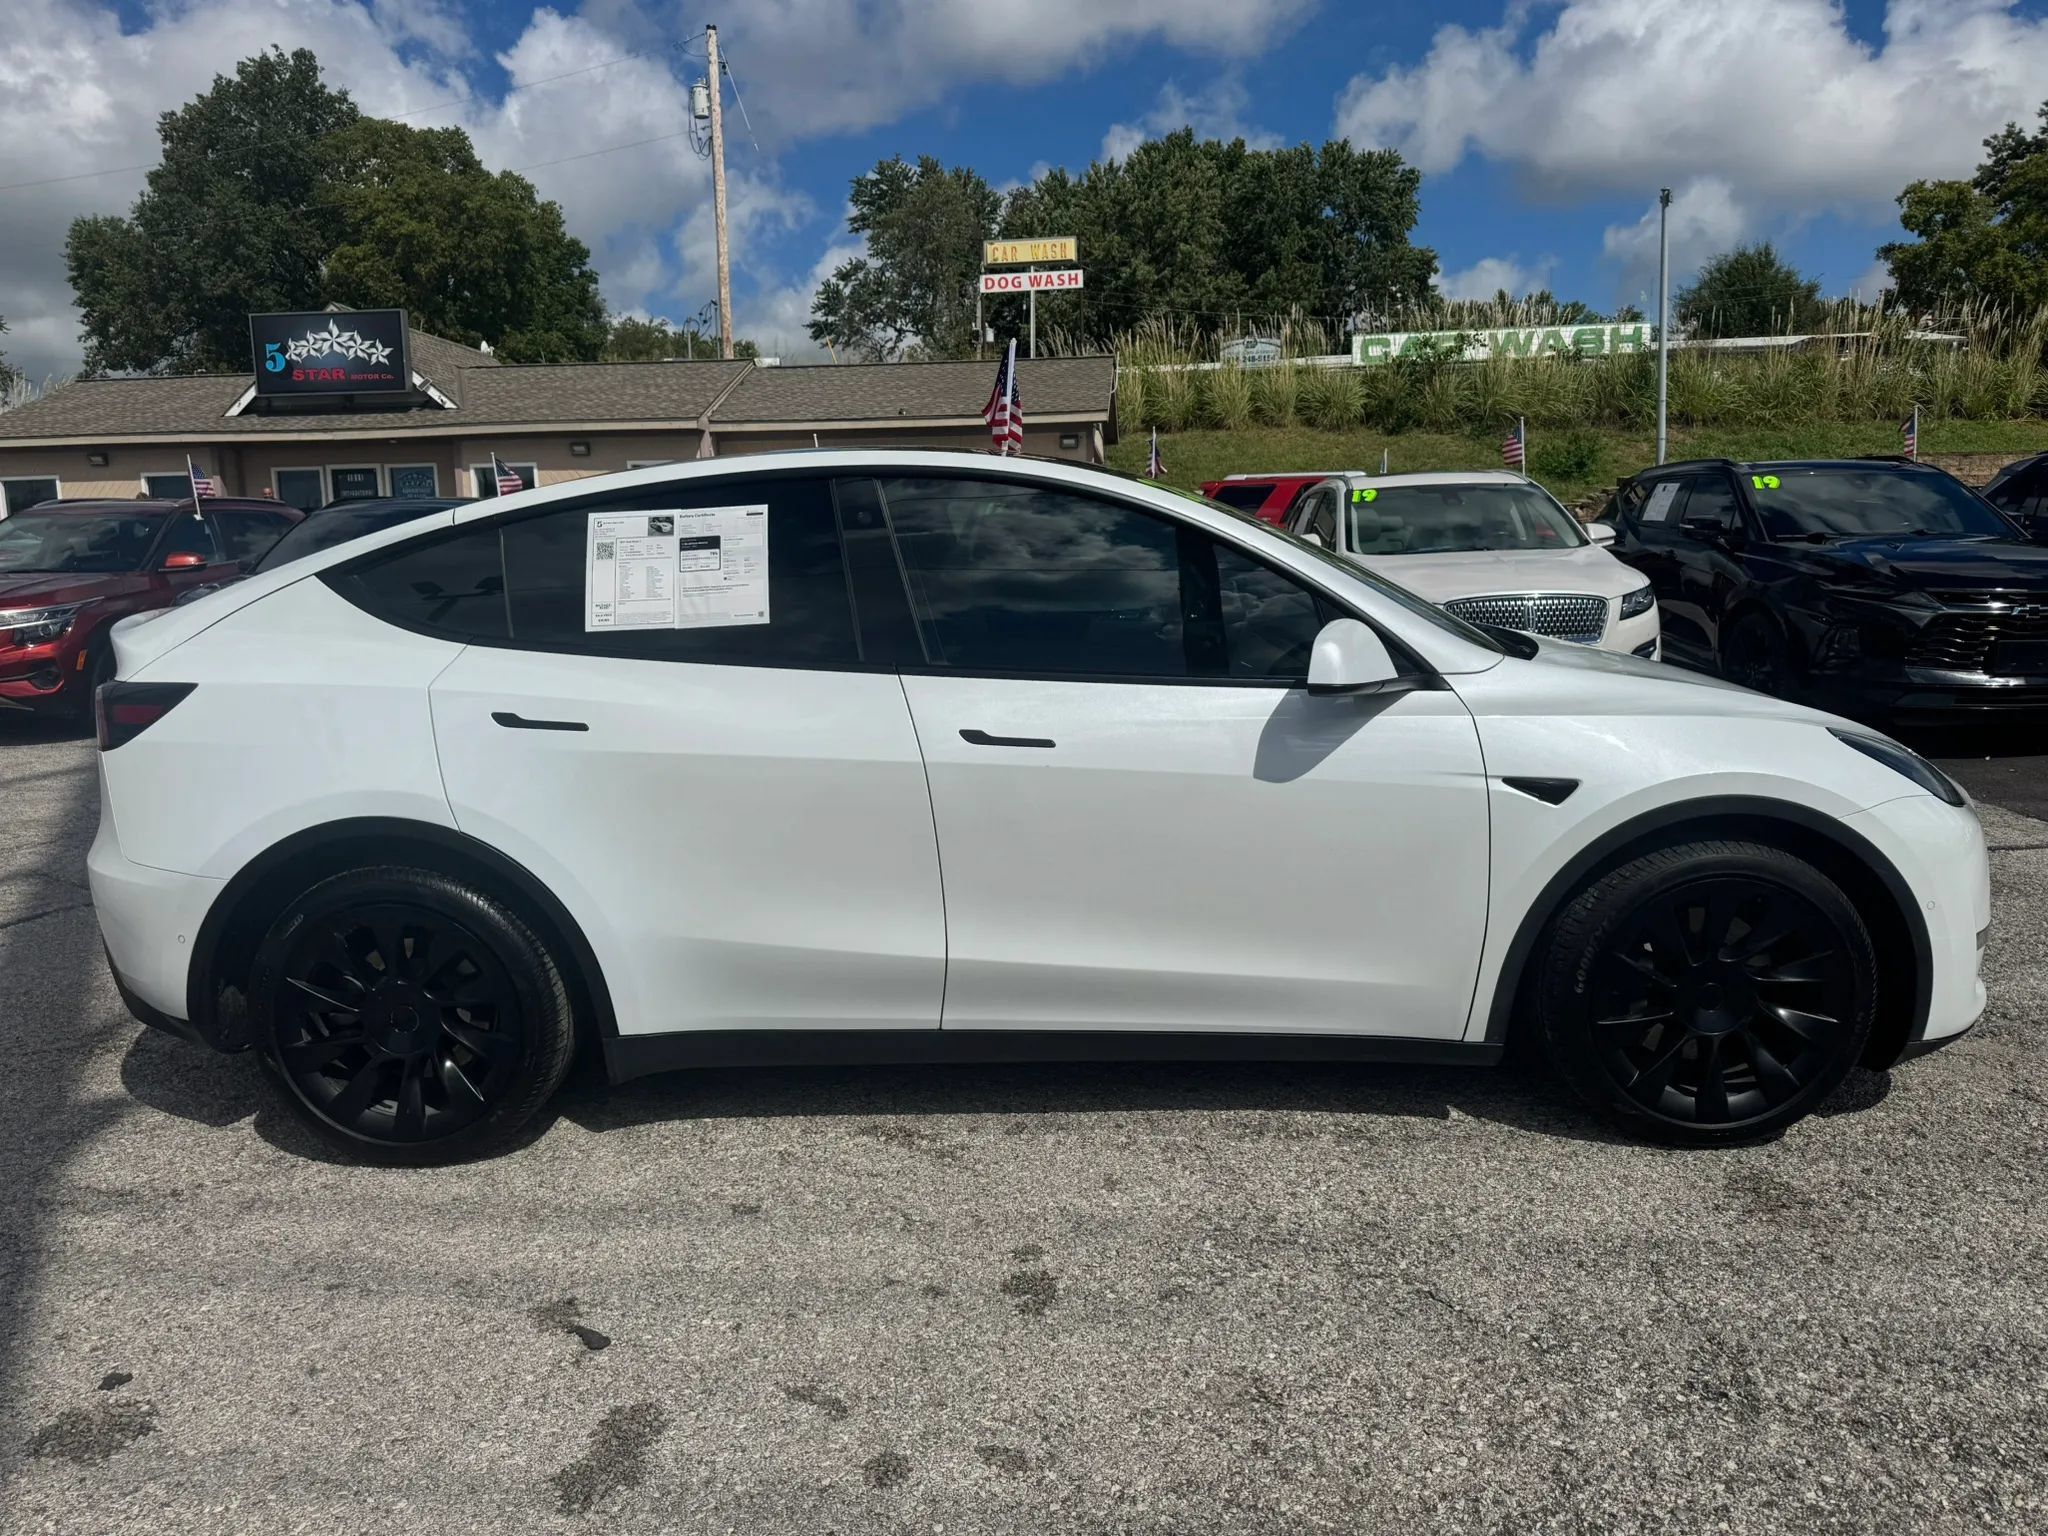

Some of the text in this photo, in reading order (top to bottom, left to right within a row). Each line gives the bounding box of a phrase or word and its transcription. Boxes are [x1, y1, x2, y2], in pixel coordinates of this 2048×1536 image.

[992, 242, 1067, 262] CAR WASH
[984, 273, 1079, 290] DOG WASH
[1488, 326, 1643, 358] WASH
[265, 342, 286, 373] 5
[292, 367, 346, 381] STAR
[1752, 475, 1781, 489] 19
[1352, 489, 1377, 503] 19
